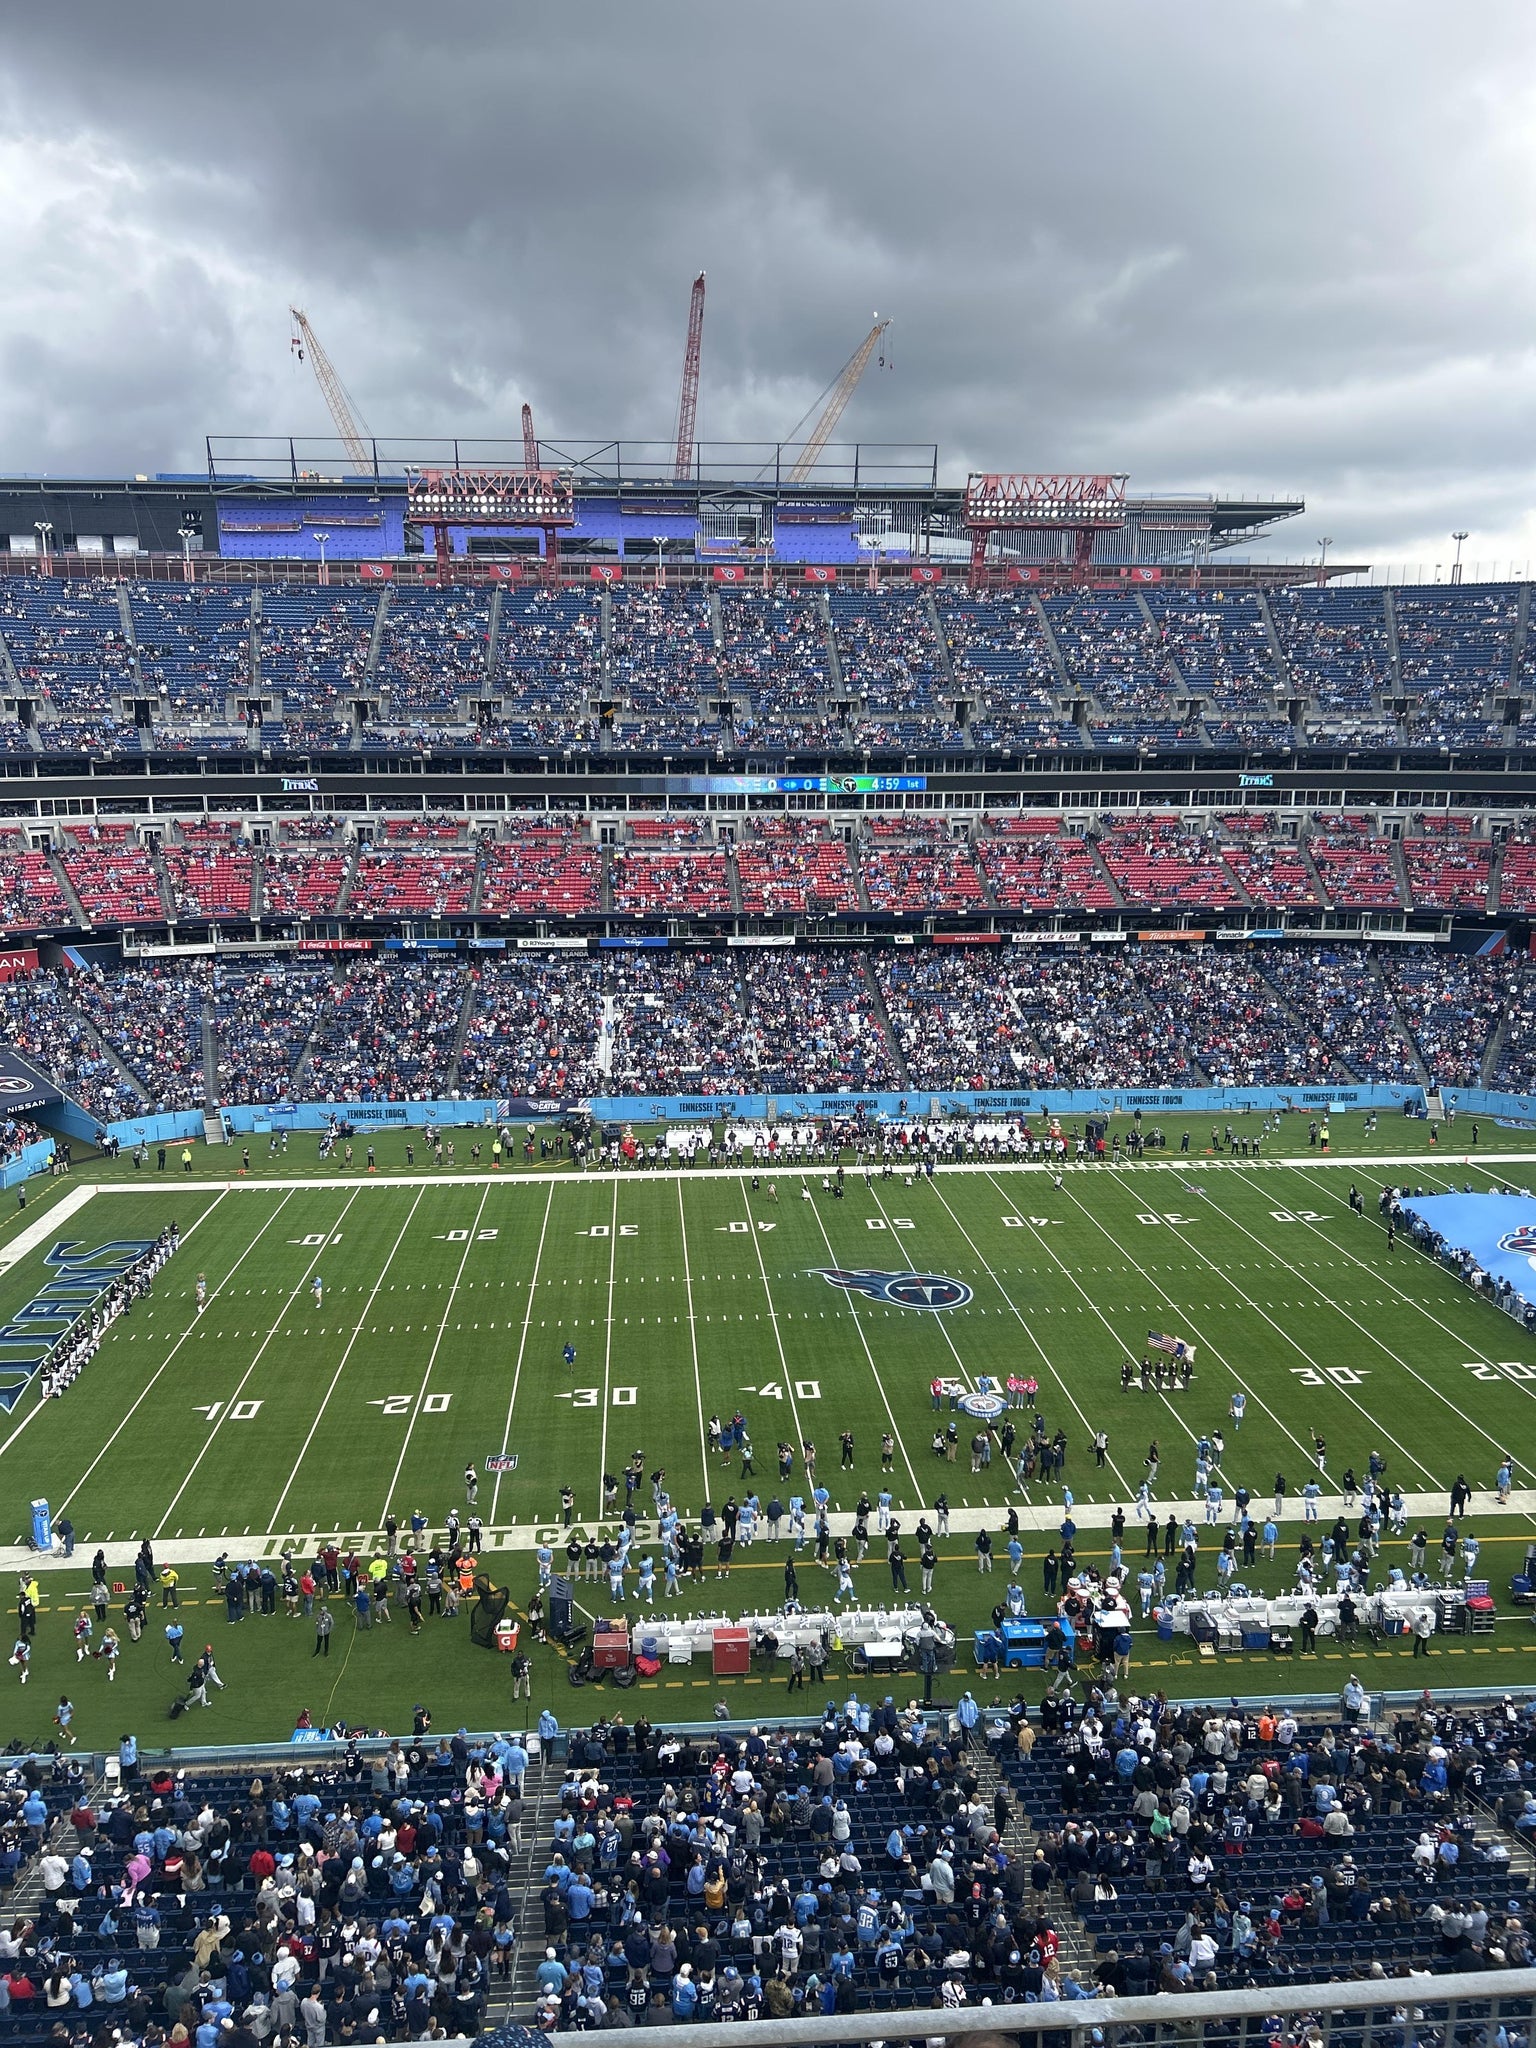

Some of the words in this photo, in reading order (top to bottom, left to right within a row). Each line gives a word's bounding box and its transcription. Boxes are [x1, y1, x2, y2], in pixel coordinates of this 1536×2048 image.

[768, 780, 777, 791] 0
[803, 779, 812, 790] 0
[871, 778, 900, 789] 4:59
[1149, 932, 1168, 940] Tito's
[291, 952, 316, 960] DAMS
[974, 1098, 1007, 1107] TENNESSEE
[1010, 1097, 1030, 1106] TOUGH
[1126, 1096, 1160, 1105] TENNESSEE
[1162, 1095, 1183, 1104] TOUGH
[1302, 1093, 1336, 1102] TENNESSEE
[1338, 1092, 1358, 1101] TOUGH
[7, 1099, 46, 1114] NISSAN
[538, 1102, 561, 1111] CATCH
[679, 1103, 712, 1112] TENNESSEE
[715, 1102, 737, 1111] TOGH
[822, 1100, 856, 1109] TENNESSEE
[346, 1109, 383, 1120] TENNESSEE
[385, 1108, 407, 1119] TOUGH
[1043, 1161, 1174, 1170] INTERCEPT
[1186, 1160, 1285, 1168] CANCER
[1001, 1215, 1049, 1228] 40
[1135, 1213, 1190, 1225] 30
[1268, 1210, 1324, 1222] 20
[588, 1224, 639, 1237] 30
[728, 1220, 777, 1233] 40
[300, 1233, 344, 1246] 10
[445, 1228, 499, 1241] 20
[1289, 1366, 1362, 1386] 30
[1461, 1362, 1535, 1380] 20
[758, 1381, 821, 1399] 40
[572, 1386, 639, 1407] 30
[382, 1393, 453, 1414] 20
[206, 1401, 265, 1420] 10
[489, 1460, 513, 1470] NFL
[114, 1583, 122, 1592] 10
[501, 1636, 511, 1646] G
[1067, 1707, 1071, 1716] 1
[1445, 1721, 1452, 1731] 8
[1248, 1730, 1257, 1740] 12
[1478, 1726, 1486, 1738] 9
[348, 1758, 354, 1767] 2
[668, 1753, 674, 1763] 3
[1475, 1775, 1482, 1786] 8
[1207, 1797, 1213, 1807] 2
[1234, 1825, 1241, 1837] 0
[137, 1843, 150, 1853] 55
[607, 1839, 617, 1853] 27
[972, 1909, 979, 1918] 3
[859, 1913, 874, 1929] 92
[321, 1938, 331, 1948] 11
[344, 1942, 355, 1952] 10
[783, 1938, 793, 1949] 12
[304, 1945, 313, 1956] 37
[392, 1949, 403, 1960] 10
[1043, 1943, 1055, 1957] 12
[885, 1956, 898, 1968] 53
[842, 1965, 846, 1974] 1
[629, 1993, 646, 2005] 98
[676, 1990, 681, 2002] 1
[747, 2008, 758, 2020] 10
